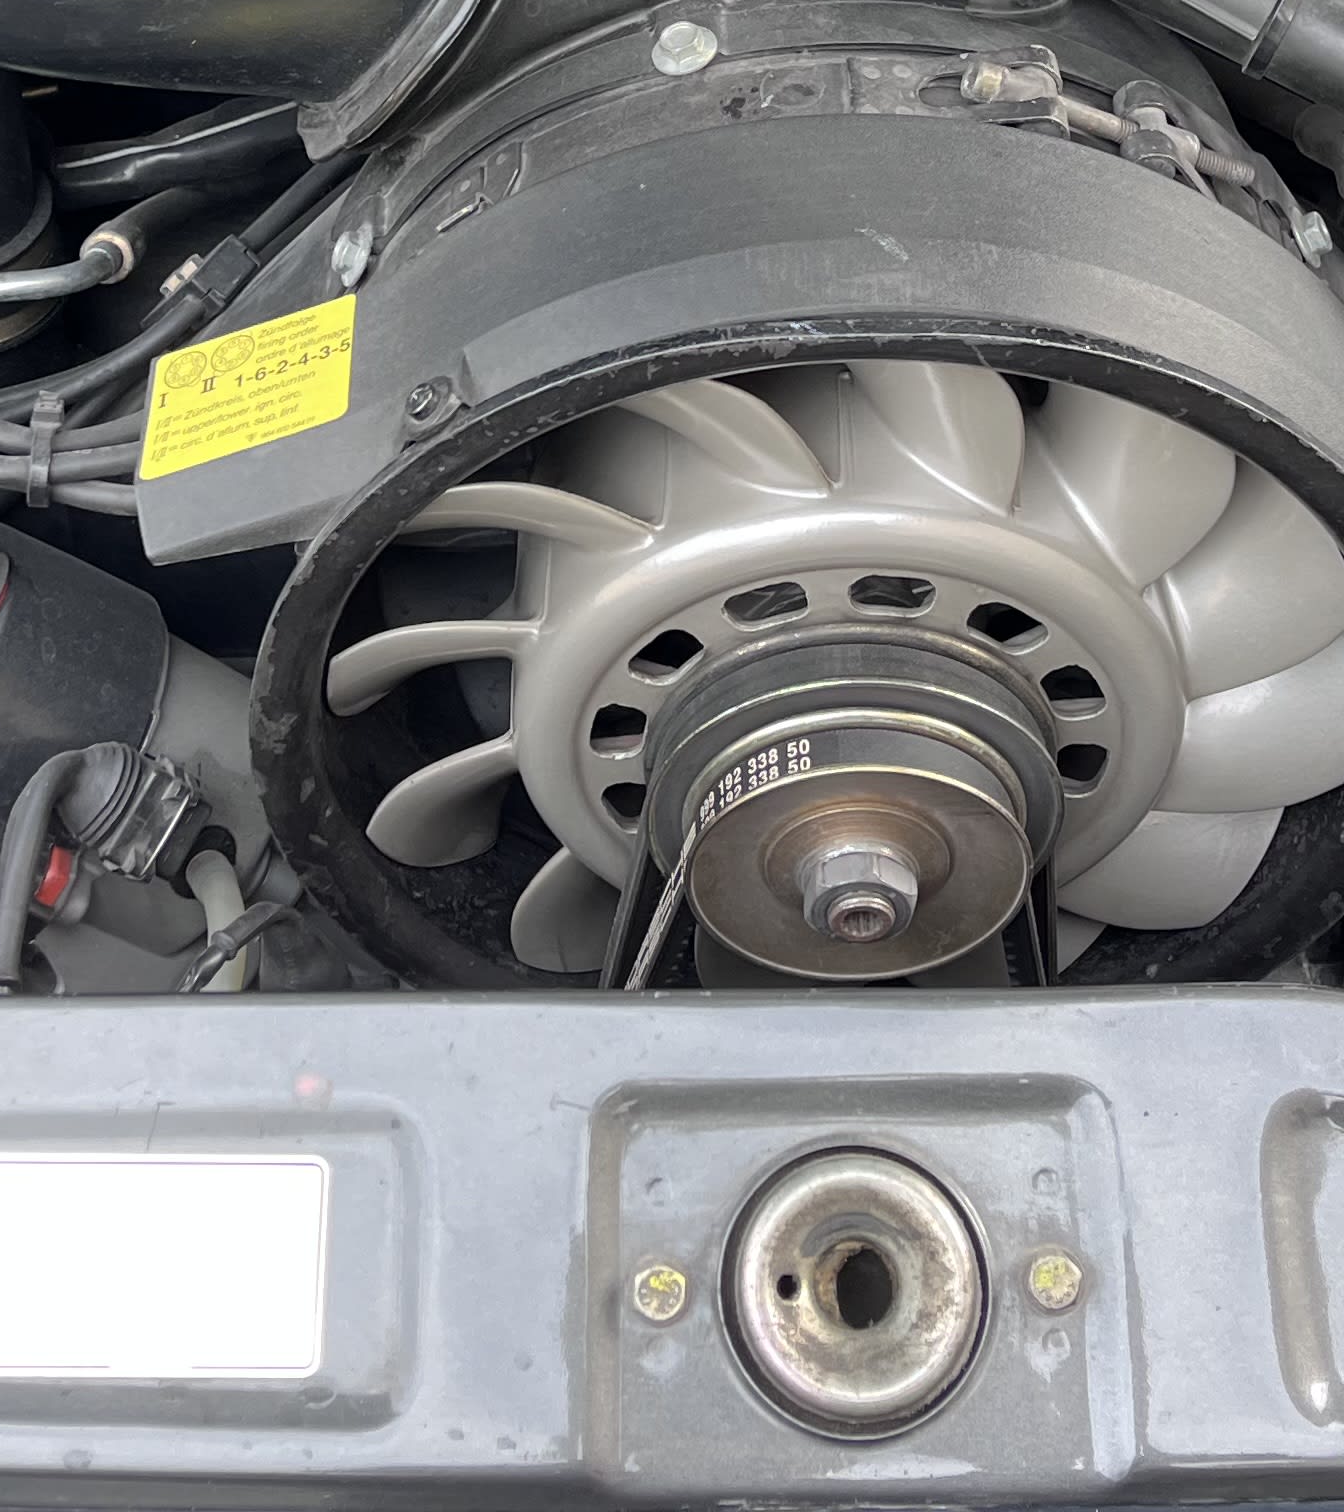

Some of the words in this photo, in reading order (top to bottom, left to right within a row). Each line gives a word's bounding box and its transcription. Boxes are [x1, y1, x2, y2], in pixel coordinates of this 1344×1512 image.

[288, 325, 319, 341] order
[235, 338, 351, 388] 1-6-2-4-3-5
[256, 347, 287, 364] ordre
[699, 790, 715, 822] 999
[718, 766, 742, 796] 192
[747, 748, 779, 775] 338
[786, 738, 811, 758] 50
[748, 765, 779, 791] 338
[787, 756, 812, 774] 50
